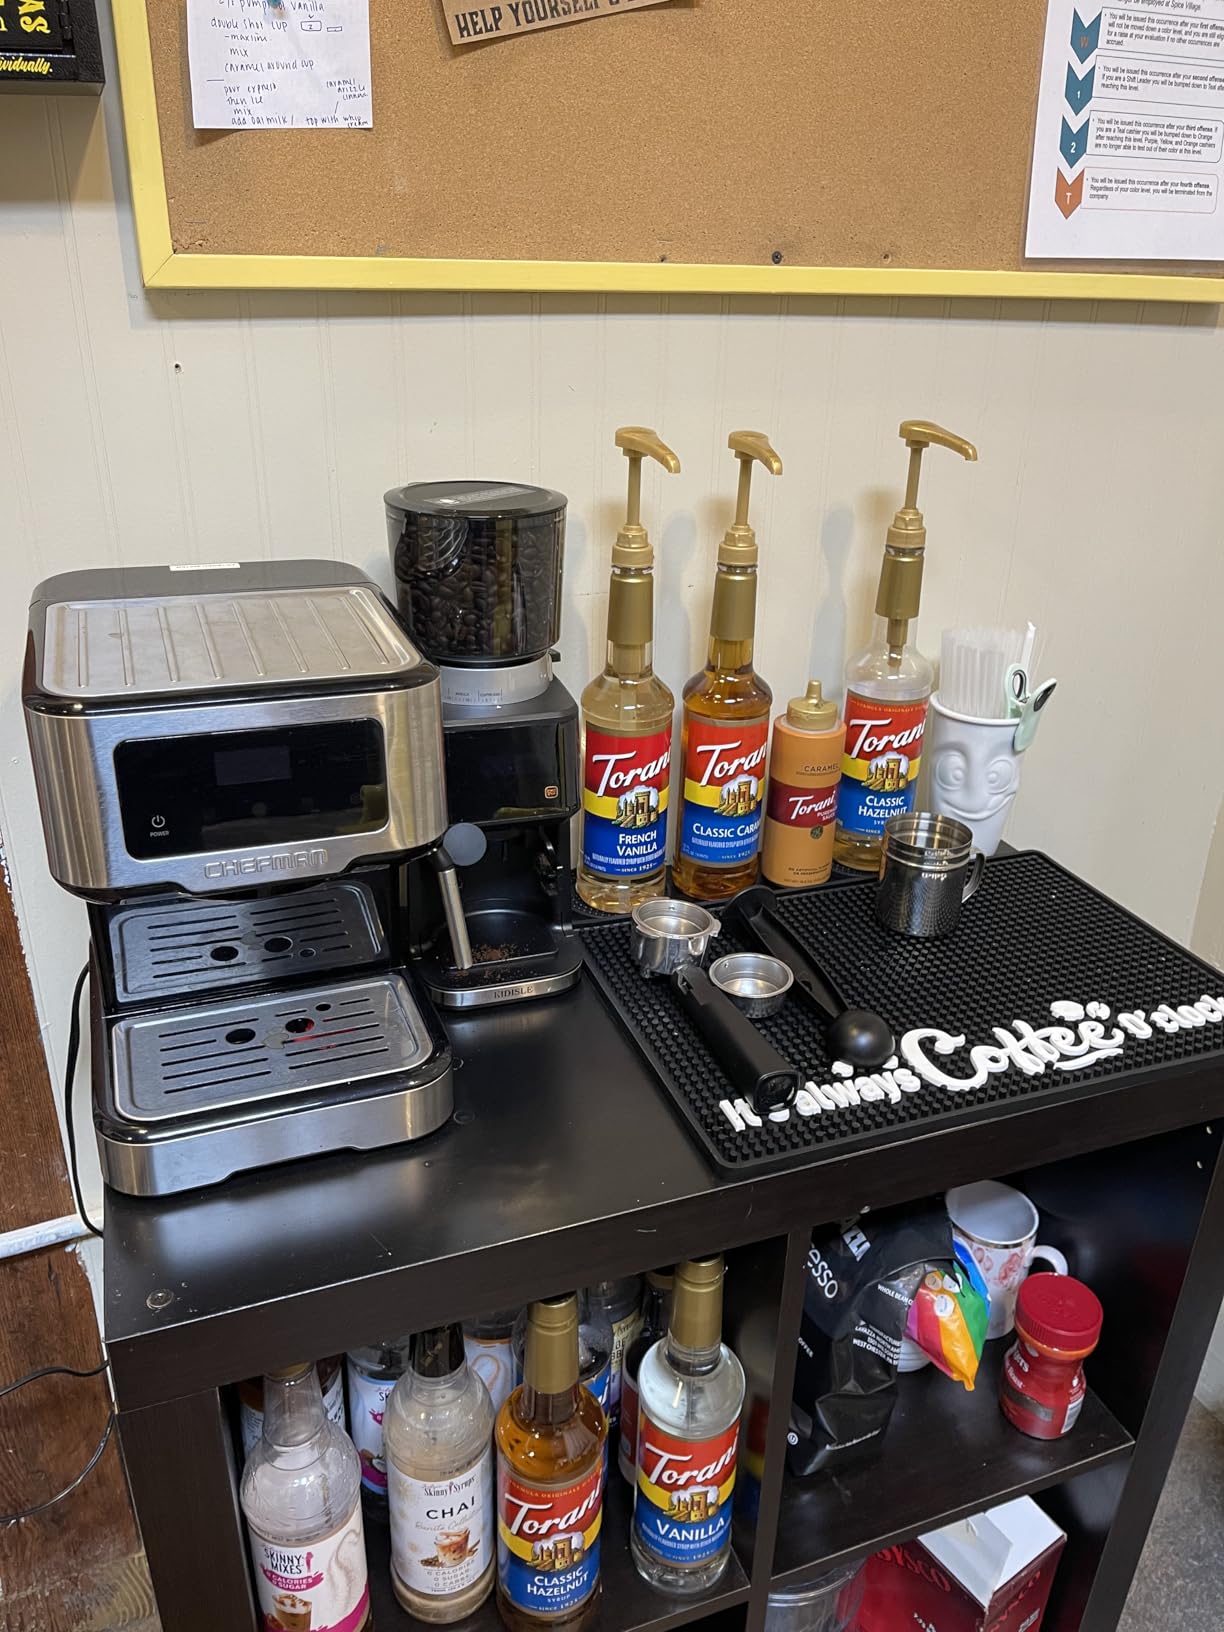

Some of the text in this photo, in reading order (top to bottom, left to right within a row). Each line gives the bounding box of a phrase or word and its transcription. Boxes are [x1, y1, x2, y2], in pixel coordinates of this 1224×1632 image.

[291, 0, 325, 12] vanilla
[1171, 0, 1183, 10] Spice
[210, 17, 238, 30] double
[243, 18, 264, 30] shot
[271, 21, 288, 32] cup
[454, 10, 503, 38] HELP
[229, 48, 249, 57] mix
[0, 57, 53, 74] ividually.
[224, 59, 315, 73] caramel around cup
[326, 78, 356, 88] caramel
[226, 96, 264, 105] then ice
[1076, 91, 1081, 99] 1
[233, 105, 253, 116] mix
[231, 116, 248, 126] add
[306, 116, 318, 127] top
[320, 115, 339, 124] with
[1071, 142, 1076, 153] 2
[1065, 192, 1072, 204] T
[804, 763, 839, 773] CARAMEL
[788, 789, 836, 820] Torani
[865, 795, 905, 807] CLASSIC
[858, 805, 908, 818] HAZELNUT
[150, 830, 170, 838] POWER
[692, 822, 735, 838] CLASSIC
[618, 830, 657, 845] FRENCH
[616, 841, 658, 856] VANILLA
[204, 848, 329, 880] CHEFMAN
[639, 863, 653, 872] 1925
[493, 986, 534, 999] KIDISLE
[793, 1067, 922, 1117] always
[900, 1019, 1125, 1092] Coffee
[877, 1283, 909, 1303] WHOLE BEAN
[424, 1487, 448, 1497] Skinny
[453, 1475, 476, 1494] Syrups
[426, 1496, 475, 1520] CHAI
[656, 1516, 725, 1541] VANILLA
[264, 1547, 302, 1564] SKINNY
[271, 1562, 303, 1575] MIXES
[436, 1559, 475, 1577] CALORIES
[442, 1568, 470, 1581] SUGAR
[272, 1574, 313, 1585] CALORIES
[534, 1566, 584, 1586] CLASSIC
[278, 1582, 307, 1590] SUGAR
[527, 1571, 589, 1597] HAZELNUT
[546, 1594, 571, 1603] SYRUP
